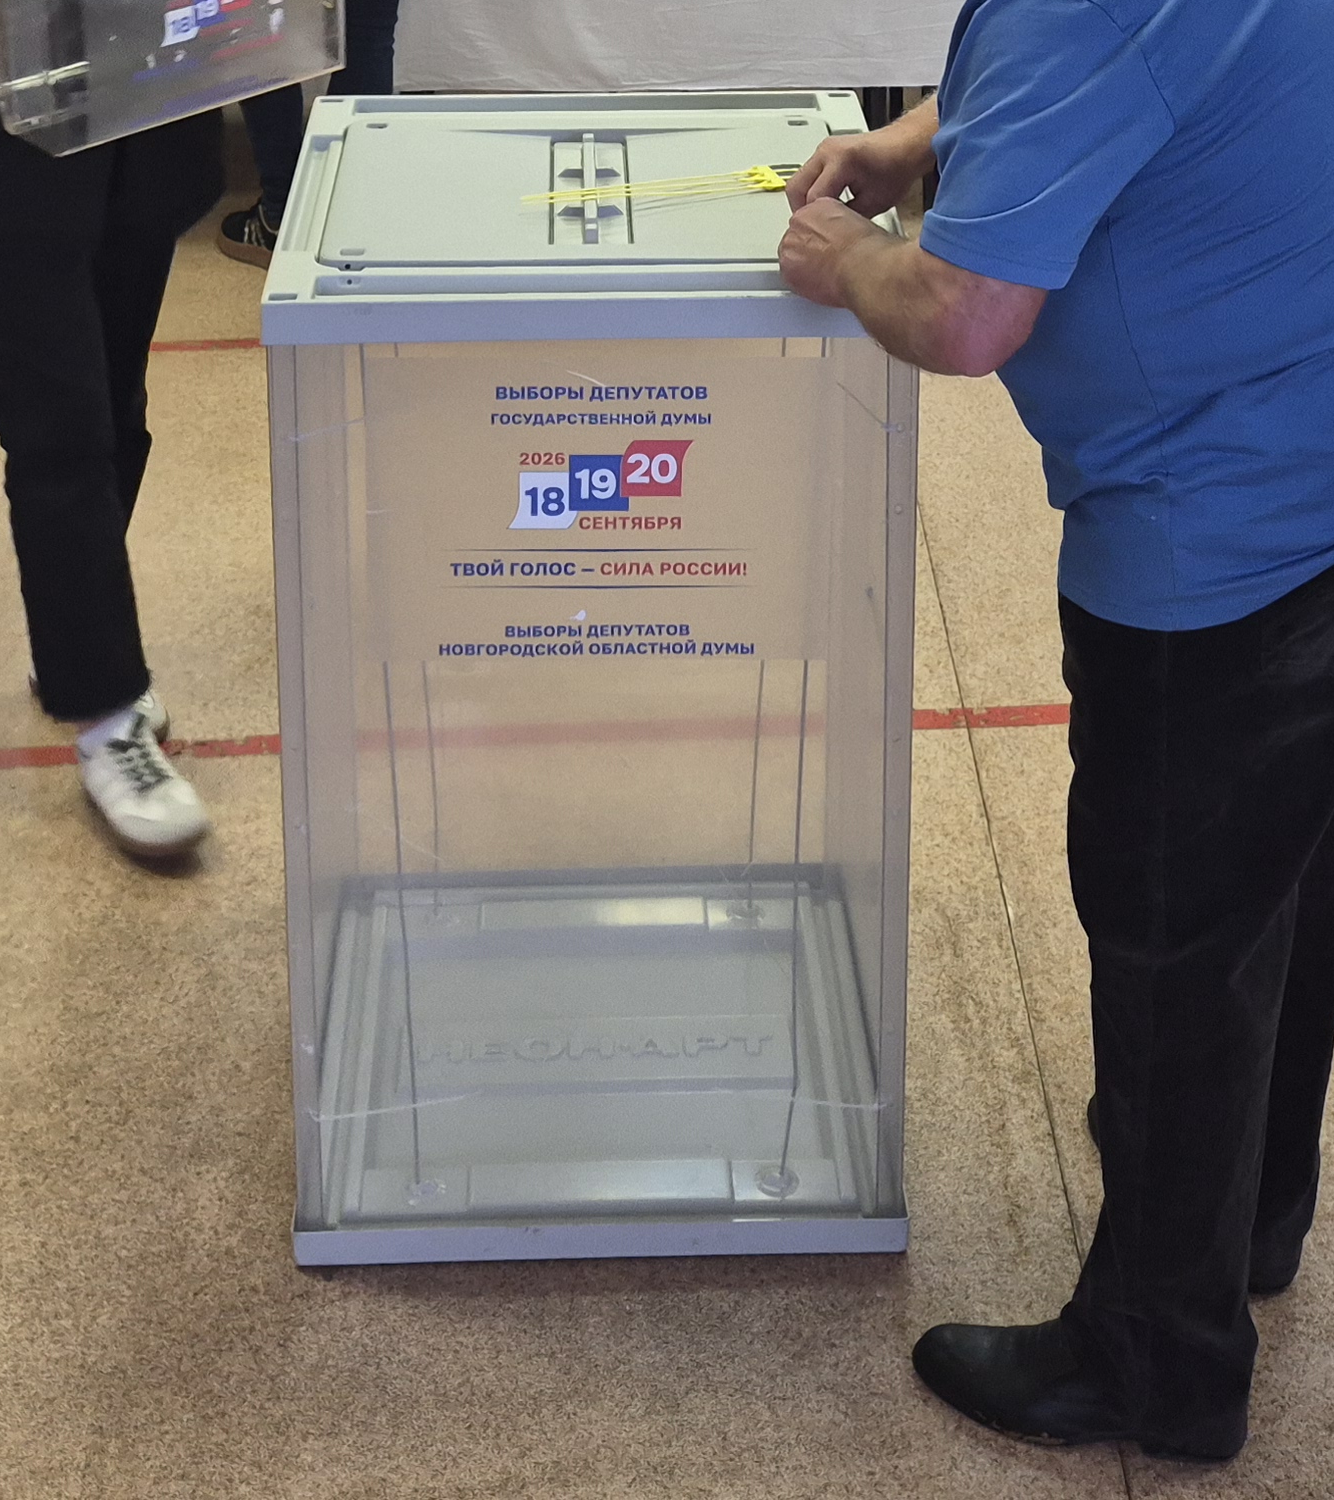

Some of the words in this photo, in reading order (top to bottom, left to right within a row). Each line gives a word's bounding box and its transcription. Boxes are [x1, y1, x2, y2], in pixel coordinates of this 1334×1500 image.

[495, 387, 584, 401] ВЫБОРЫ
[588, 386, 708, 402] ДЕПУТАТОВ
[490, 410, 657, 427] ГОСУДАРСТВЕННОЙ
[660, 412, 712, 427] ДУМЫ
[519, 452, 566, 466] 2026
[626, 453, 678, 484] 20
[575, 468, 617, 499] 19
[524, 486, 566, 517] 18
[578, 517, 682, 531] СЕНТЯБРЯ
[450, 560, 505, 577] ТВОЙ
[509, 562, 576, 577] ГОЛОС
[600, 562, 655, 577] СИЛА
[660, 562, 747, 577] РОССИИ!
[504, 625, 582, 638] ВЫБОРЫ
[585, 624, 690, 639] ДЕПУТАТОВ
[438, 640, 584, 657] НОВГОРОДСКОЙ
[588, 639, 696, 656] ОБЛАСТНОЙ
[700, 641, 755, 656] ДУМЫ
